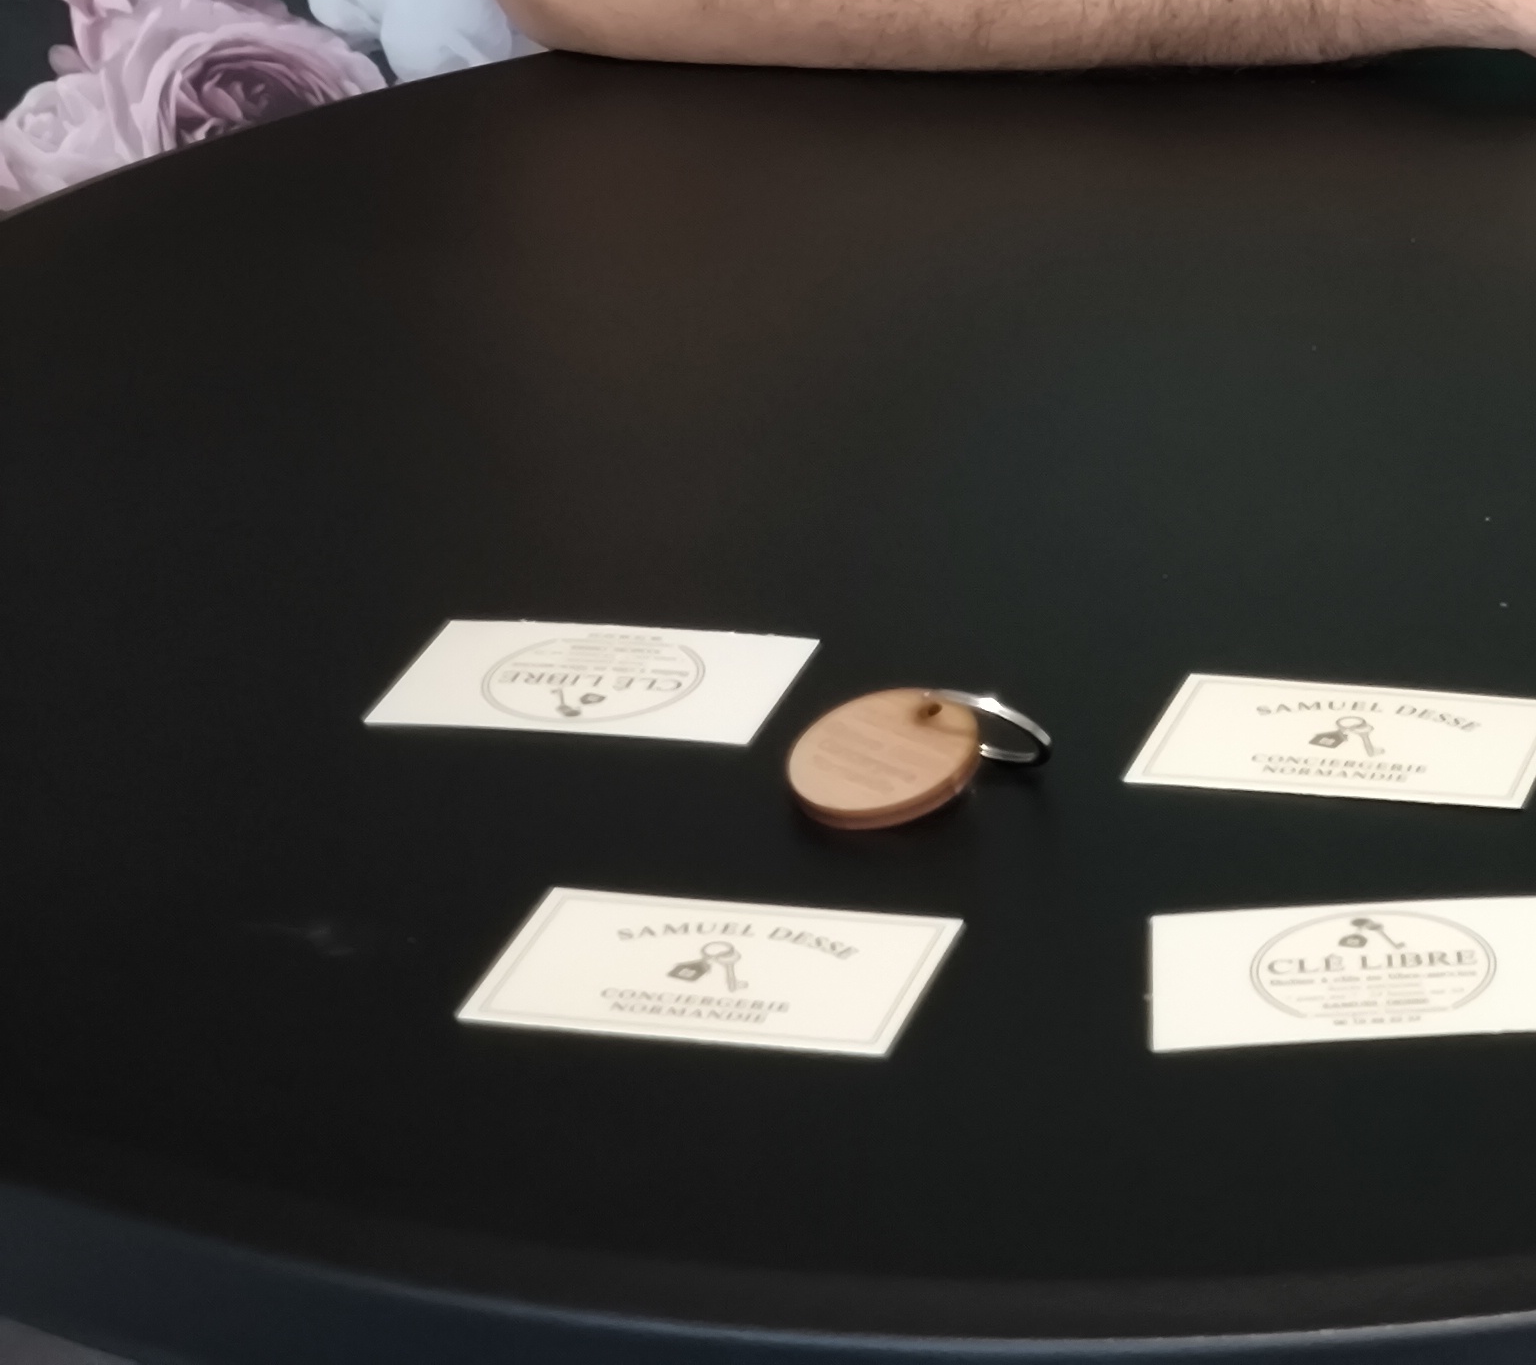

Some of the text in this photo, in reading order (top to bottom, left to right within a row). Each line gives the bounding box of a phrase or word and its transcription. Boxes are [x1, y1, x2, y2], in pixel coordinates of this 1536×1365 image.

[1256, 701, 1383, 716] SAMUEL
[1251, 754, 1428, 774] CONCIERGERIE
[1262, 764, 1409, 783] NORMANDIE
[616, 922, 755, 941] SAMUEL
[1360, 950, 1478, 970] LIBRE
[600, 987, 791, 1014] CONCIERGERIE
